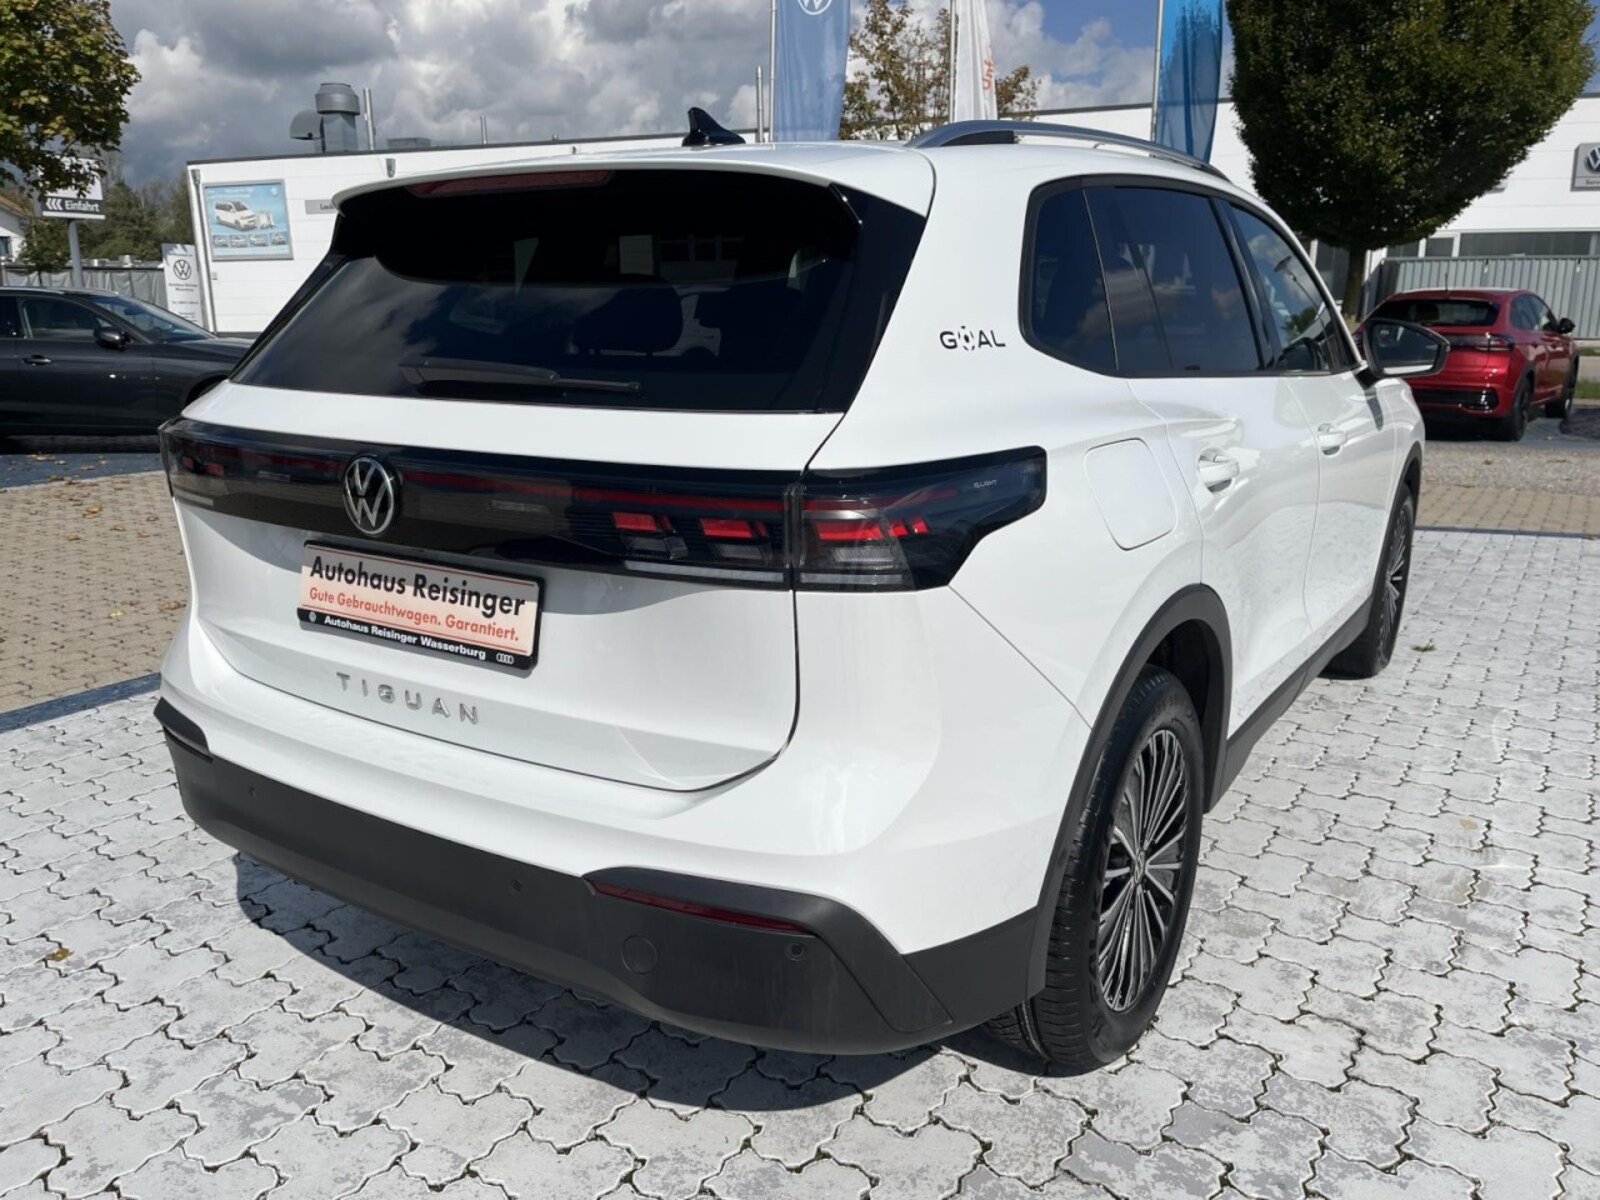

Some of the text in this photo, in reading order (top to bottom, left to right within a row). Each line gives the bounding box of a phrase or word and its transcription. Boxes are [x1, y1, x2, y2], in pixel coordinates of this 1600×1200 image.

[64, 199, 101, 213] Einfahrt
[309, 586, 519, 641] Gute Gebrauchtwagen. Garantiert.
[310, 555, 526, 619] Autohaus Reisinger
[324, 615, 487, 660] Autohaus Reisinger Wasserburg
[336, 671, 479, 726] TIGUAN
